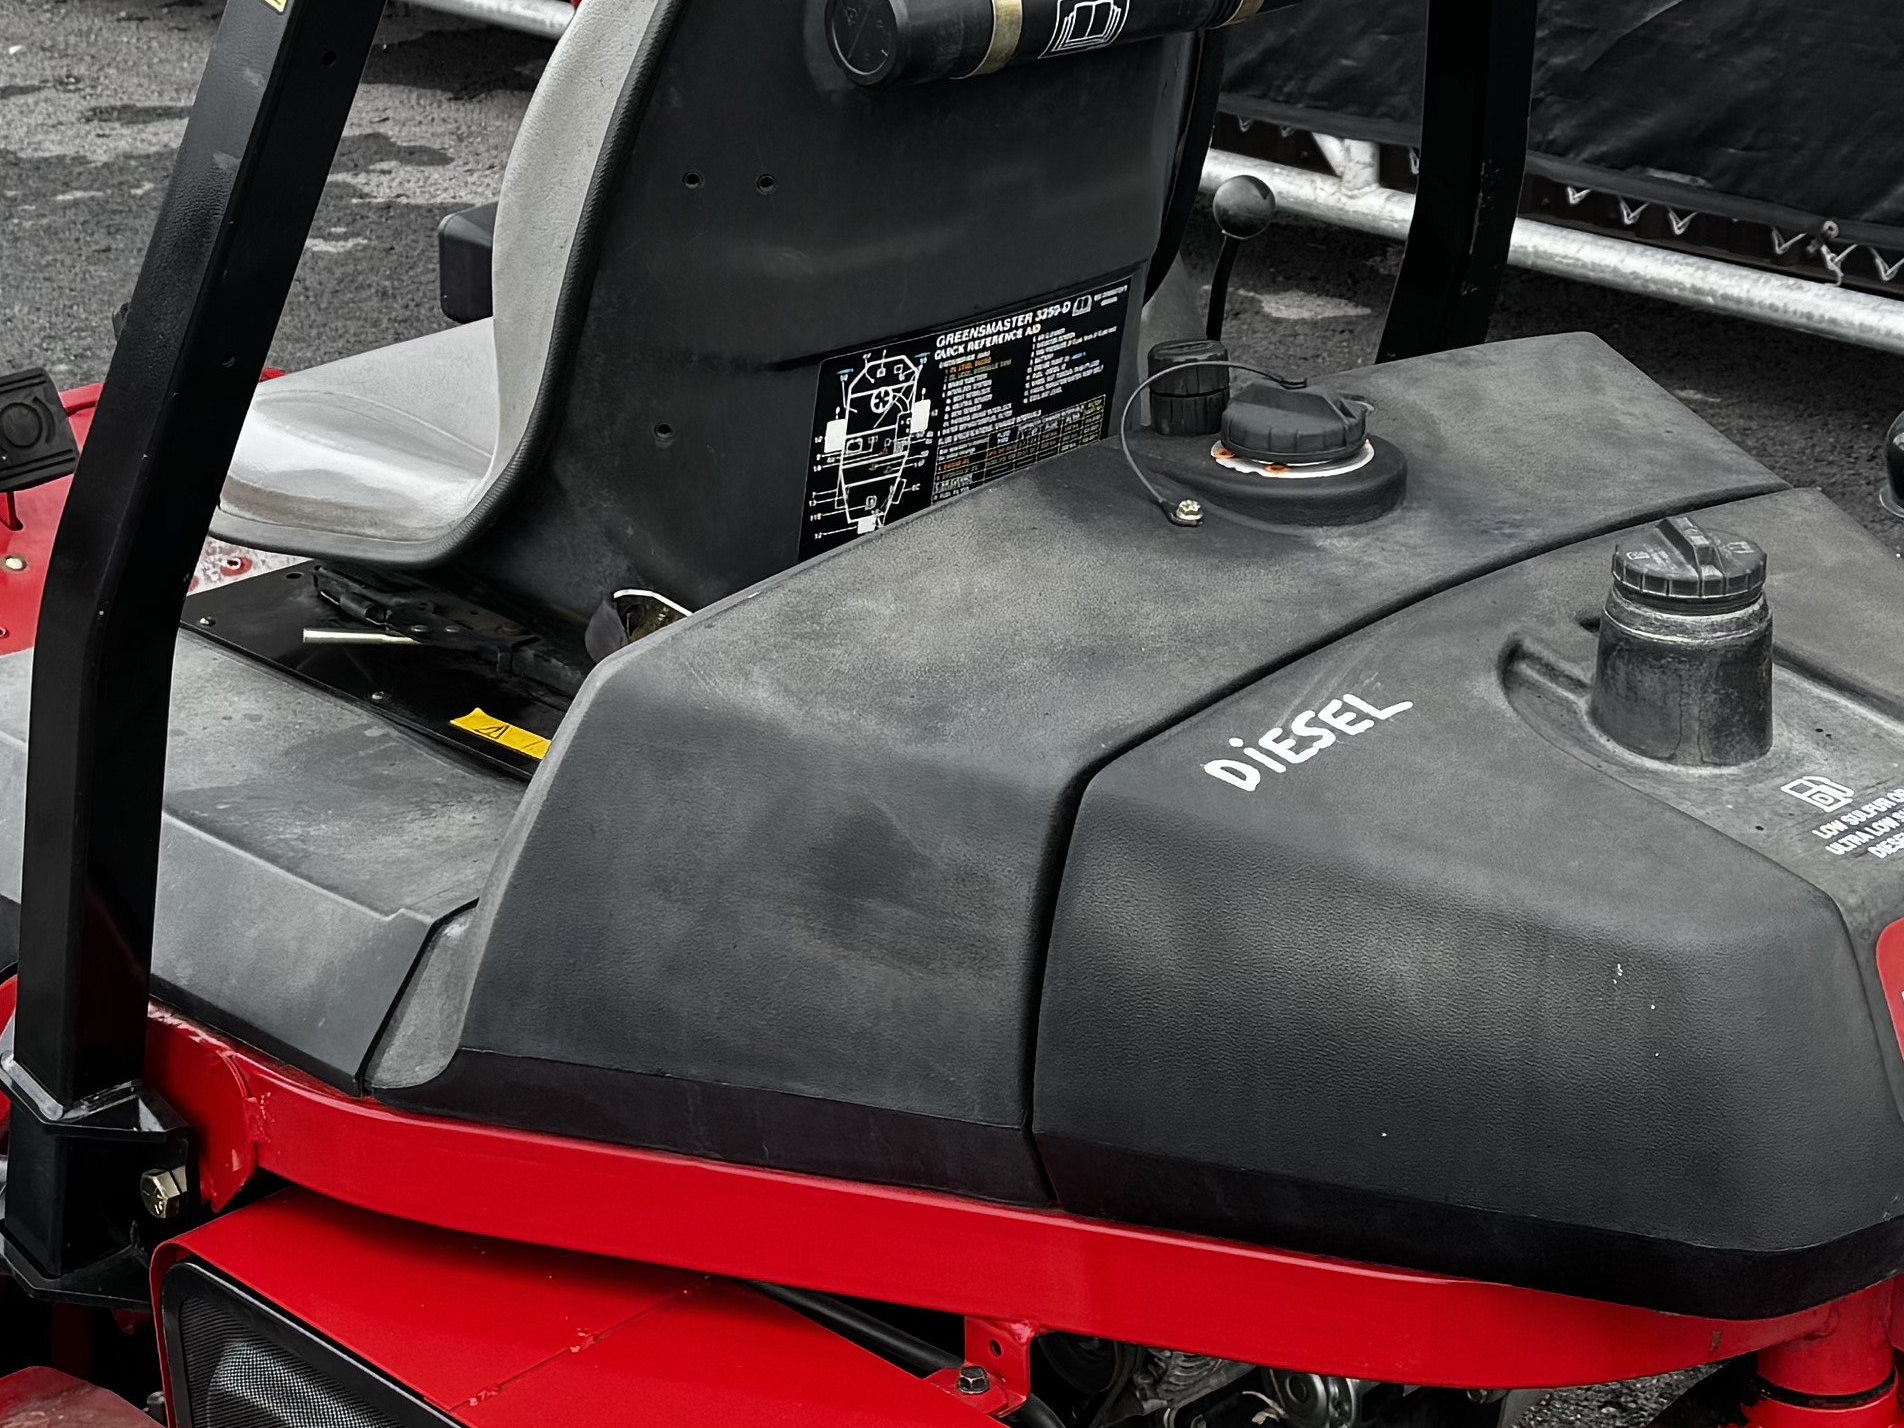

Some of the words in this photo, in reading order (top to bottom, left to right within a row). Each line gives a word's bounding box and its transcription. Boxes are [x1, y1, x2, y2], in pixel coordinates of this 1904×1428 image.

[935, 312, 1034, 348] GREENSMASTER
[966, 329, 1024, 352] REFERENCE
[1811, 819, 1849, 840] LOW
[1825, 830, 1875, 855] ULTRA
[1864, 815, 1900, 837] LOW
